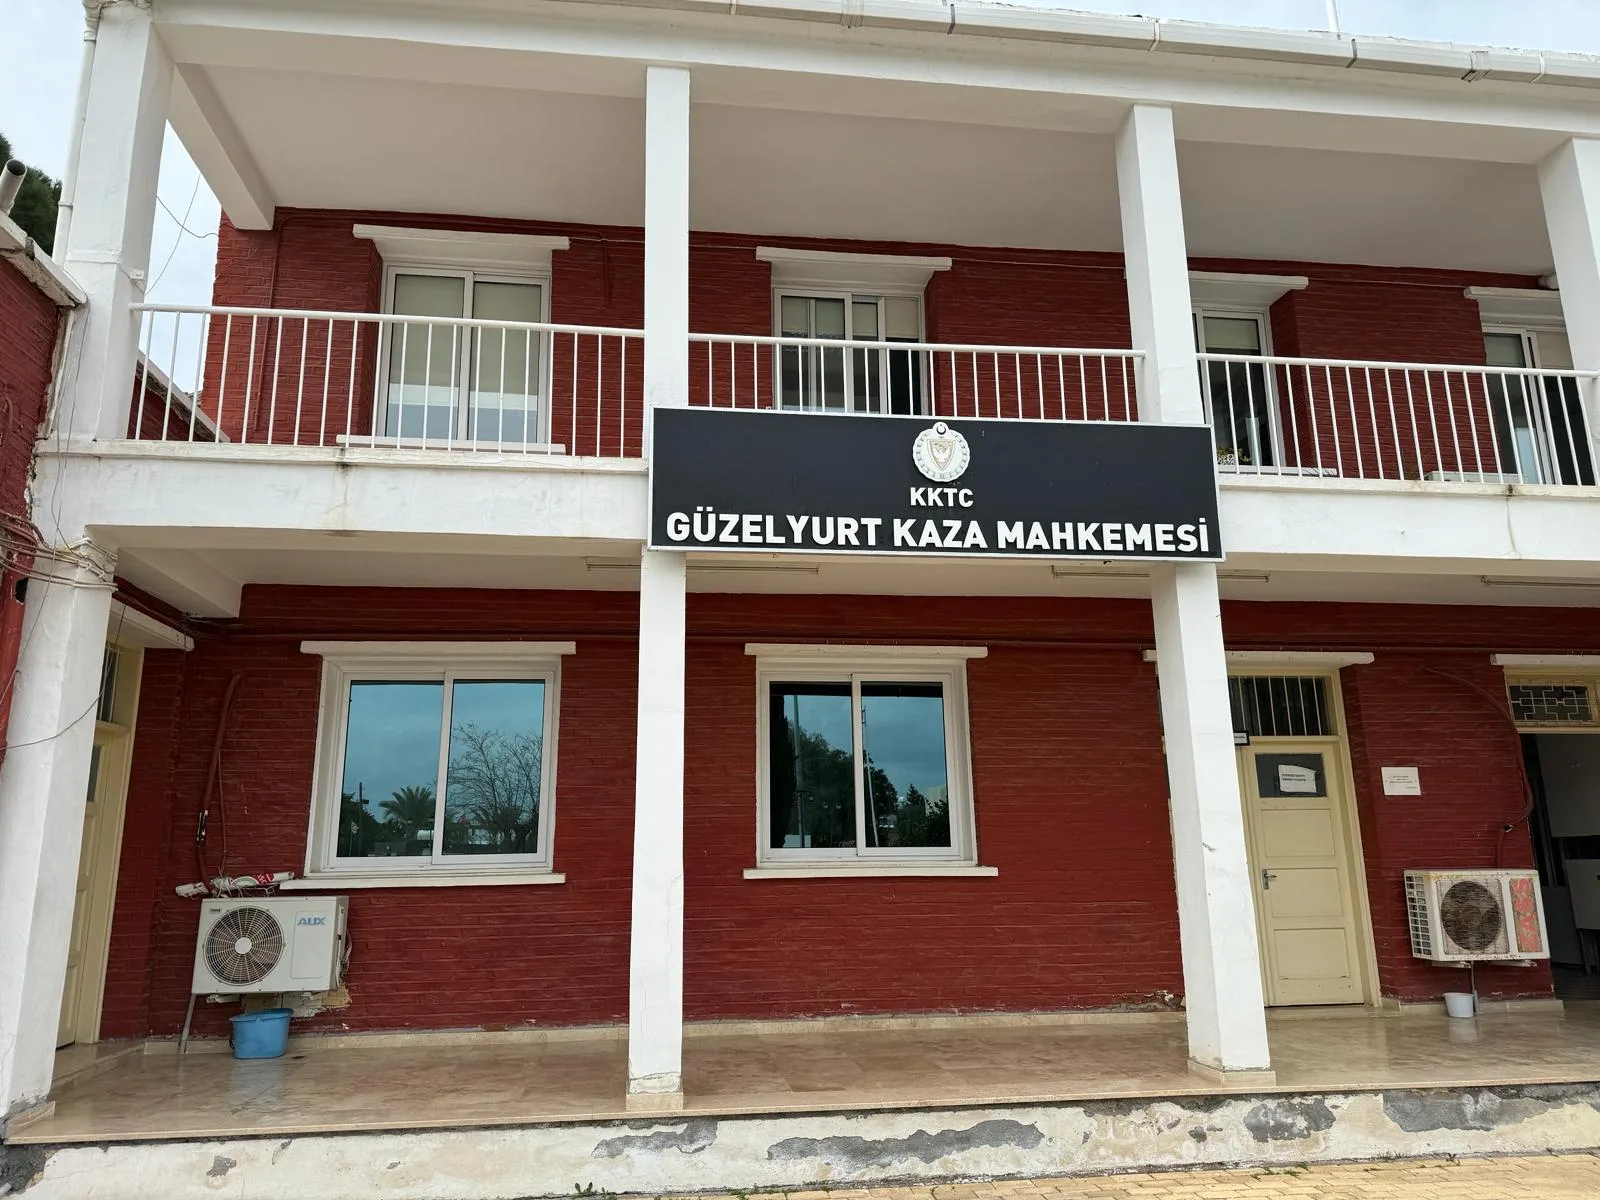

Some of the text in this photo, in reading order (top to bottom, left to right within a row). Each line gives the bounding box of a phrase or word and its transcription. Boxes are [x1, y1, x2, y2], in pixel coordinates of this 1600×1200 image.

[910, 487, 974, 508] KKTC
[666, 507, 1209, 554] GÜZELYURT KAZA MAHKEMESİ
[297, 916, 326, 927] AUX
